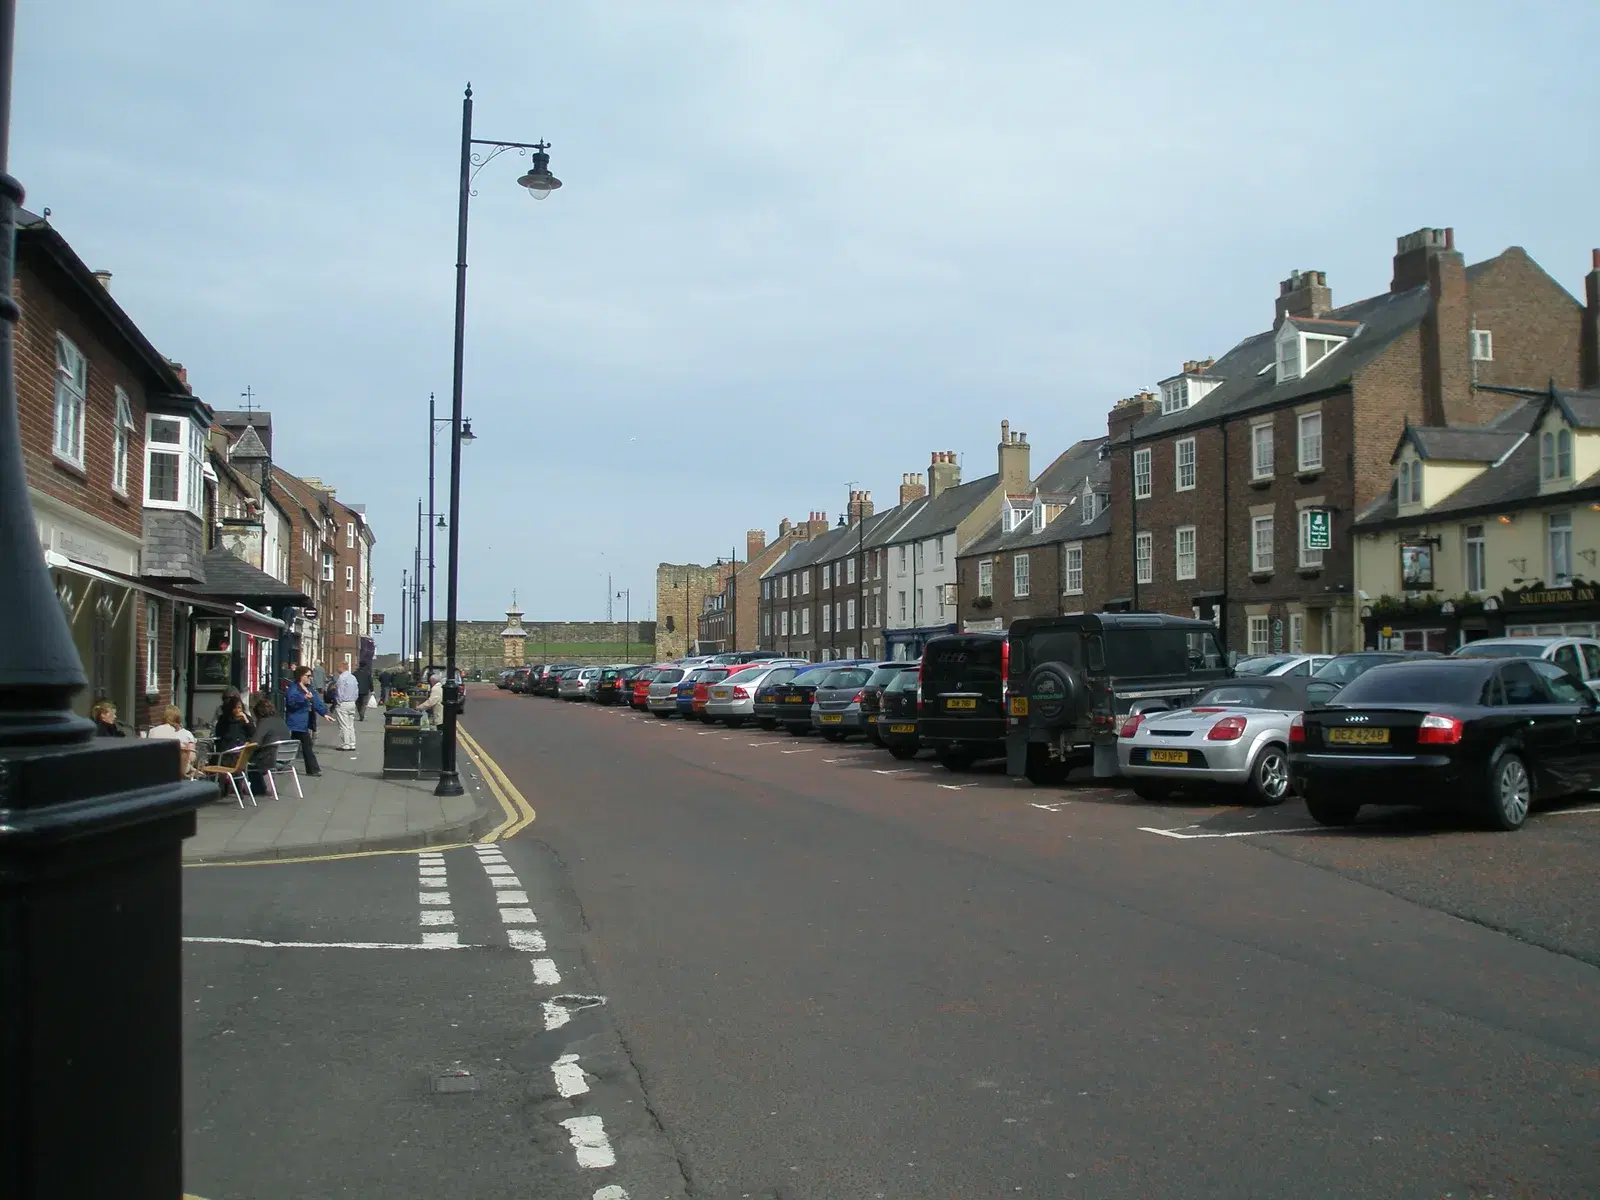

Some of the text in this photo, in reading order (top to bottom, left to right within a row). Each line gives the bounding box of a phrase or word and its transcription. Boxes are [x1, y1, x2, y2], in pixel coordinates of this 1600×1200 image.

[1520, 588, 1595, 604] SALUTATION INN
[1334, 729, 1353, 740] DEZ
